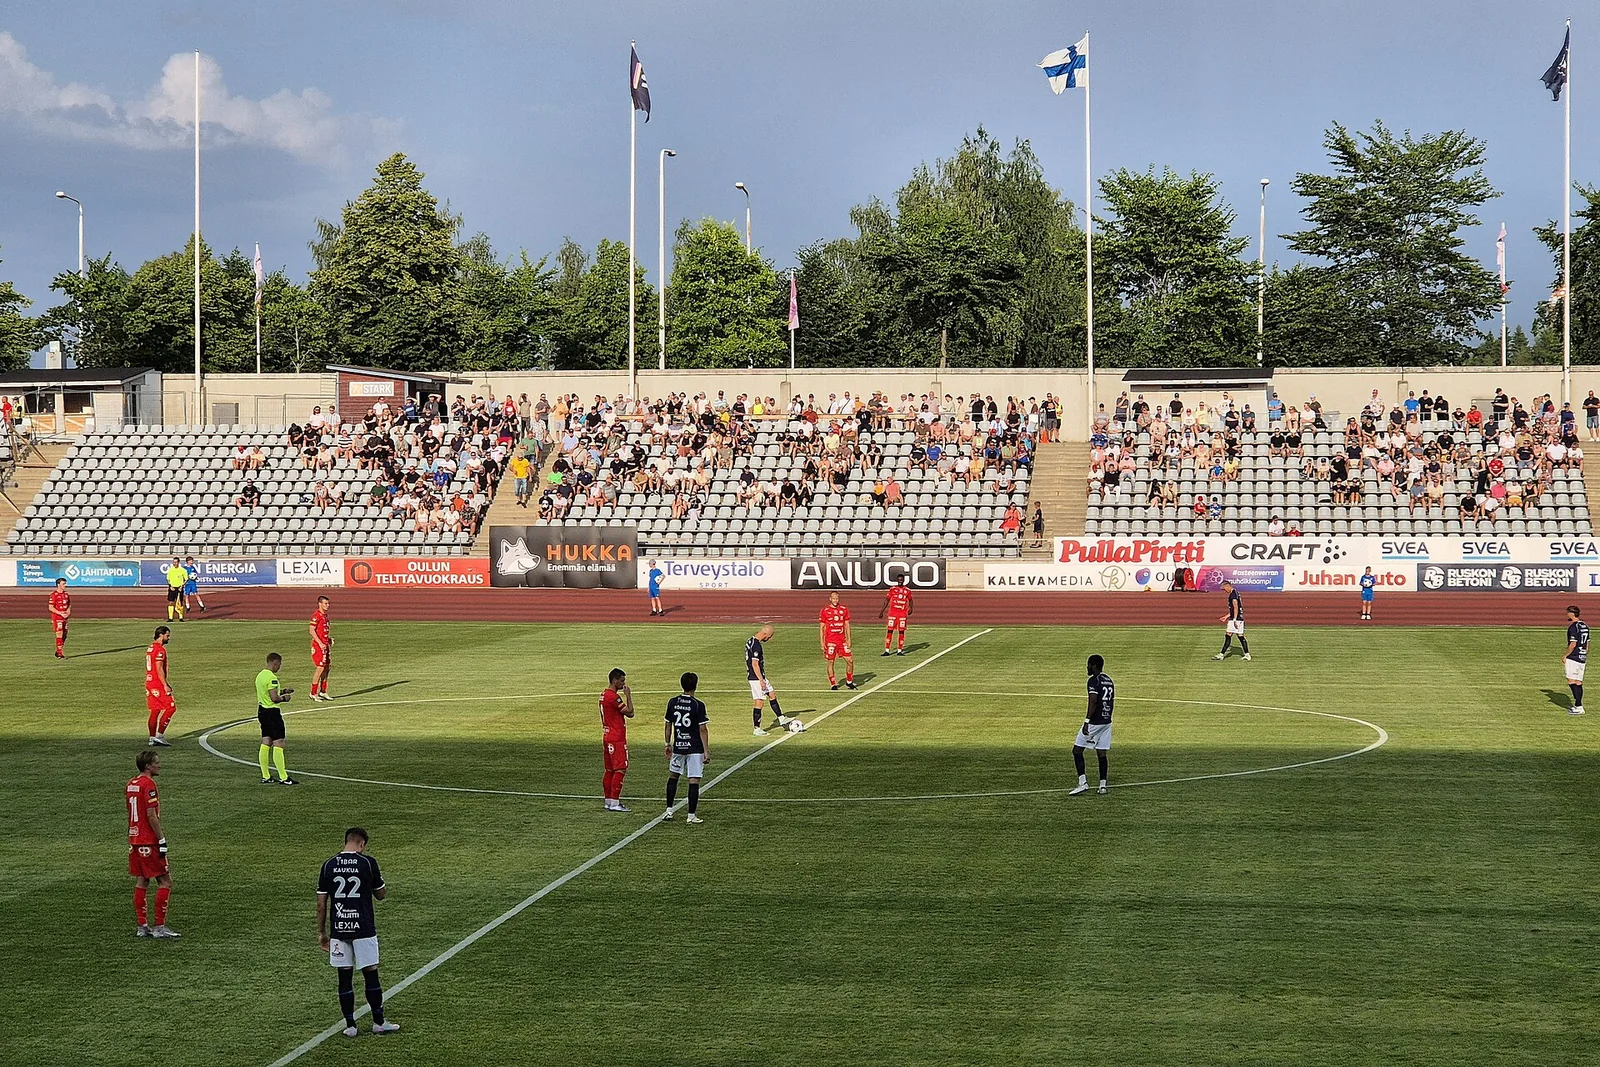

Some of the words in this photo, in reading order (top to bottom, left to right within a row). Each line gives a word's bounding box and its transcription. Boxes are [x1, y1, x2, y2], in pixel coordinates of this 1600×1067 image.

[363, 384, 393, 394] STARK
[547, 544, 632, 561] HUKKA
[1058, 539, 1205, 563] PullaPirtti
[1230, 543, 1320, 560] CRAFT
[1382, 542, 1429, 554] SVEA
[1462, 542, 1510, 554] SVEA
[1550, 542, 1598, 555] SVEA
[80, 567, 133, 576] LÄHITAPIOLA
[205, 562, 258, 574] ENERGIA
[283, 561, 331, 574] LEXIA
[408, 562, 450, 571] OULUN
[547, 563, 586, 571] Enemmän
[587, 563, 616, 571] elämää
[664, 560, 765, 580] Terveystalo
[375, 574, 484, 584] TELTTAVUOKRAUS
[797, 561, 940, 587] ANUCO
[1299, 570, 1356, 585] Juhan
[1374, 572, 1407, 585] uto
[1447, 569, 1497, 578] RUSKON
[1525, 569, 1574, 578] RUSKON
[988, 577, 1094, 585] KALEVAMEDIA
[1447, 578, 1492, 586] BETONI
[1525, 578, 1570, 586] BETONI
[674, 711, 691, 728] 26
[333, 876, 361, 898] 22
[334, 921, 360, 929] LEXIA
